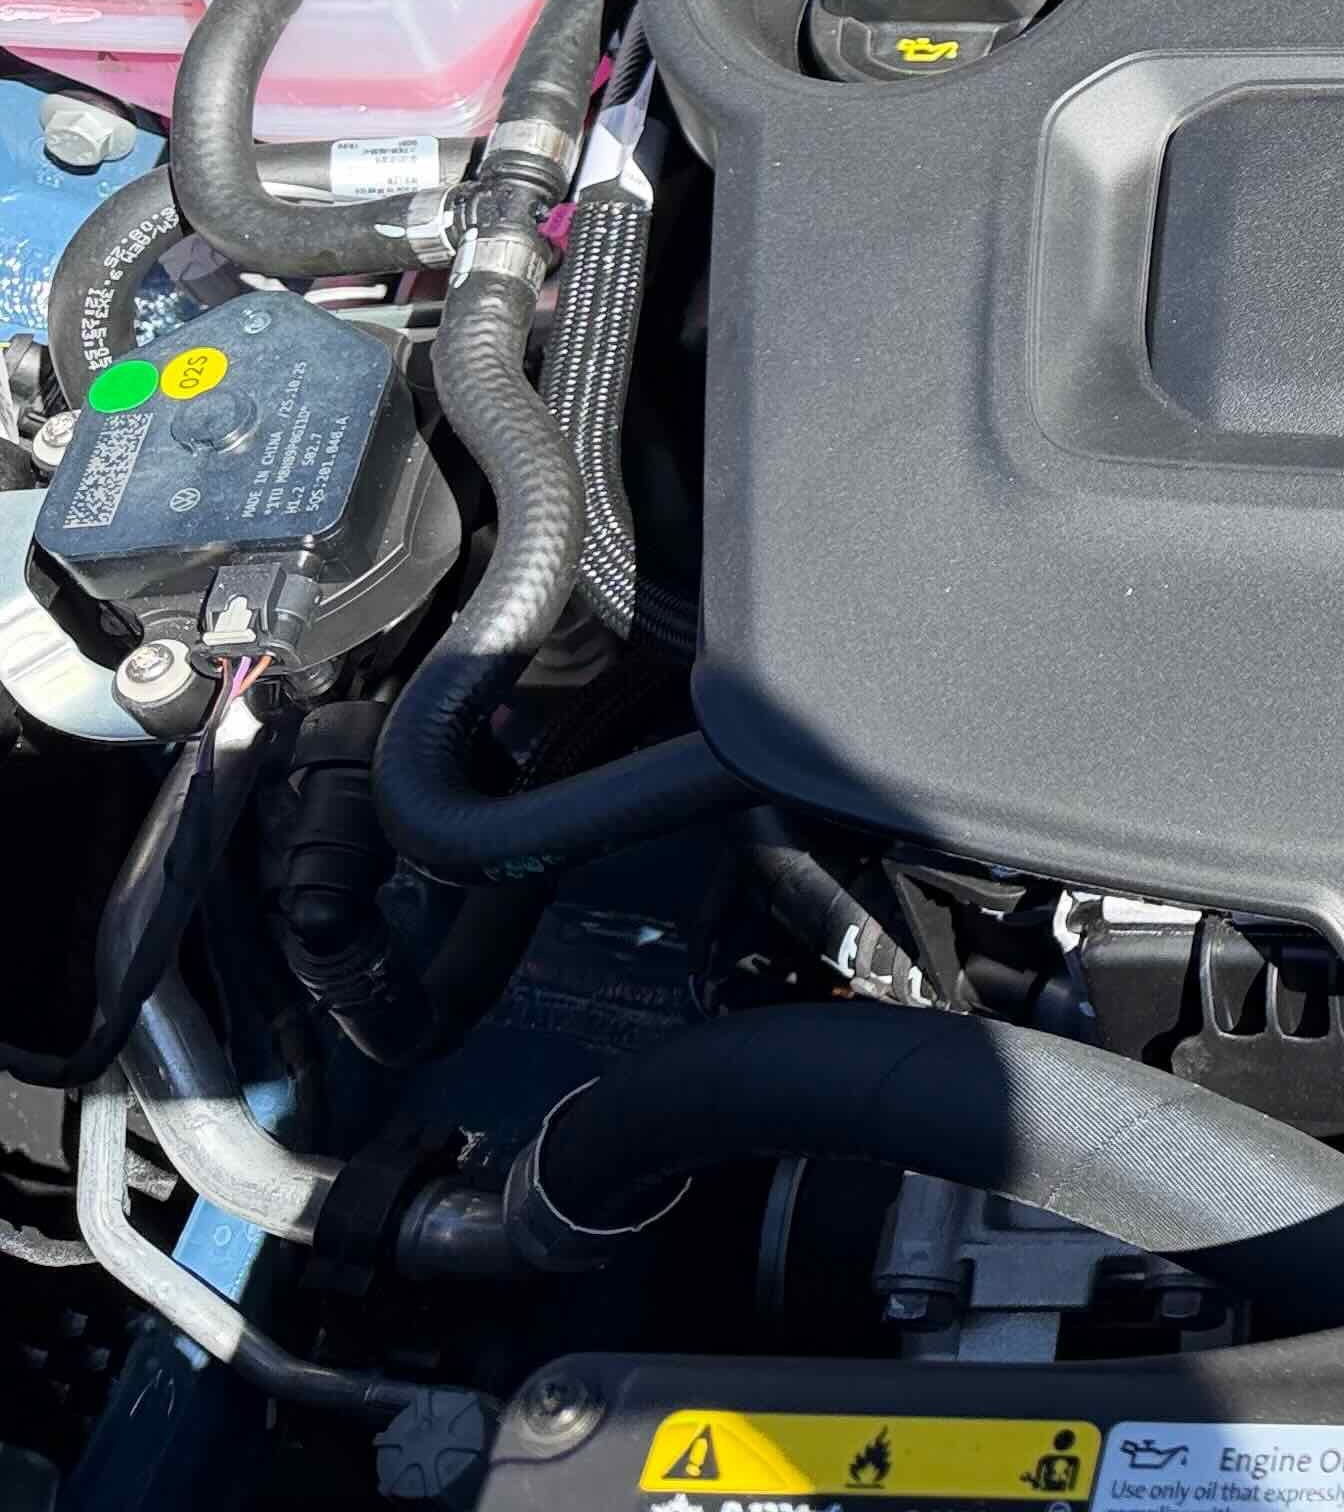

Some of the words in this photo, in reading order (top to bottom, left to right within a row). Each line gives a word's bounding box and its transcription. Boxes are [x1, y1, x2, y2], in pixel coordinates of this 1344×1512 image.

[260, 431, 284, 465] CHINA
[254, 470, 271, 485] IN
[241, 488, 263, 518] MADE
[1218, 1445, 1312, 1480] Engine
[1110, 1480, 1147, 1502] Use
[1149, 1481, 1192, 1505] only
[1193, 1480, 1220, 1501] oil
[1220, 1482, 1260, 1503] that
